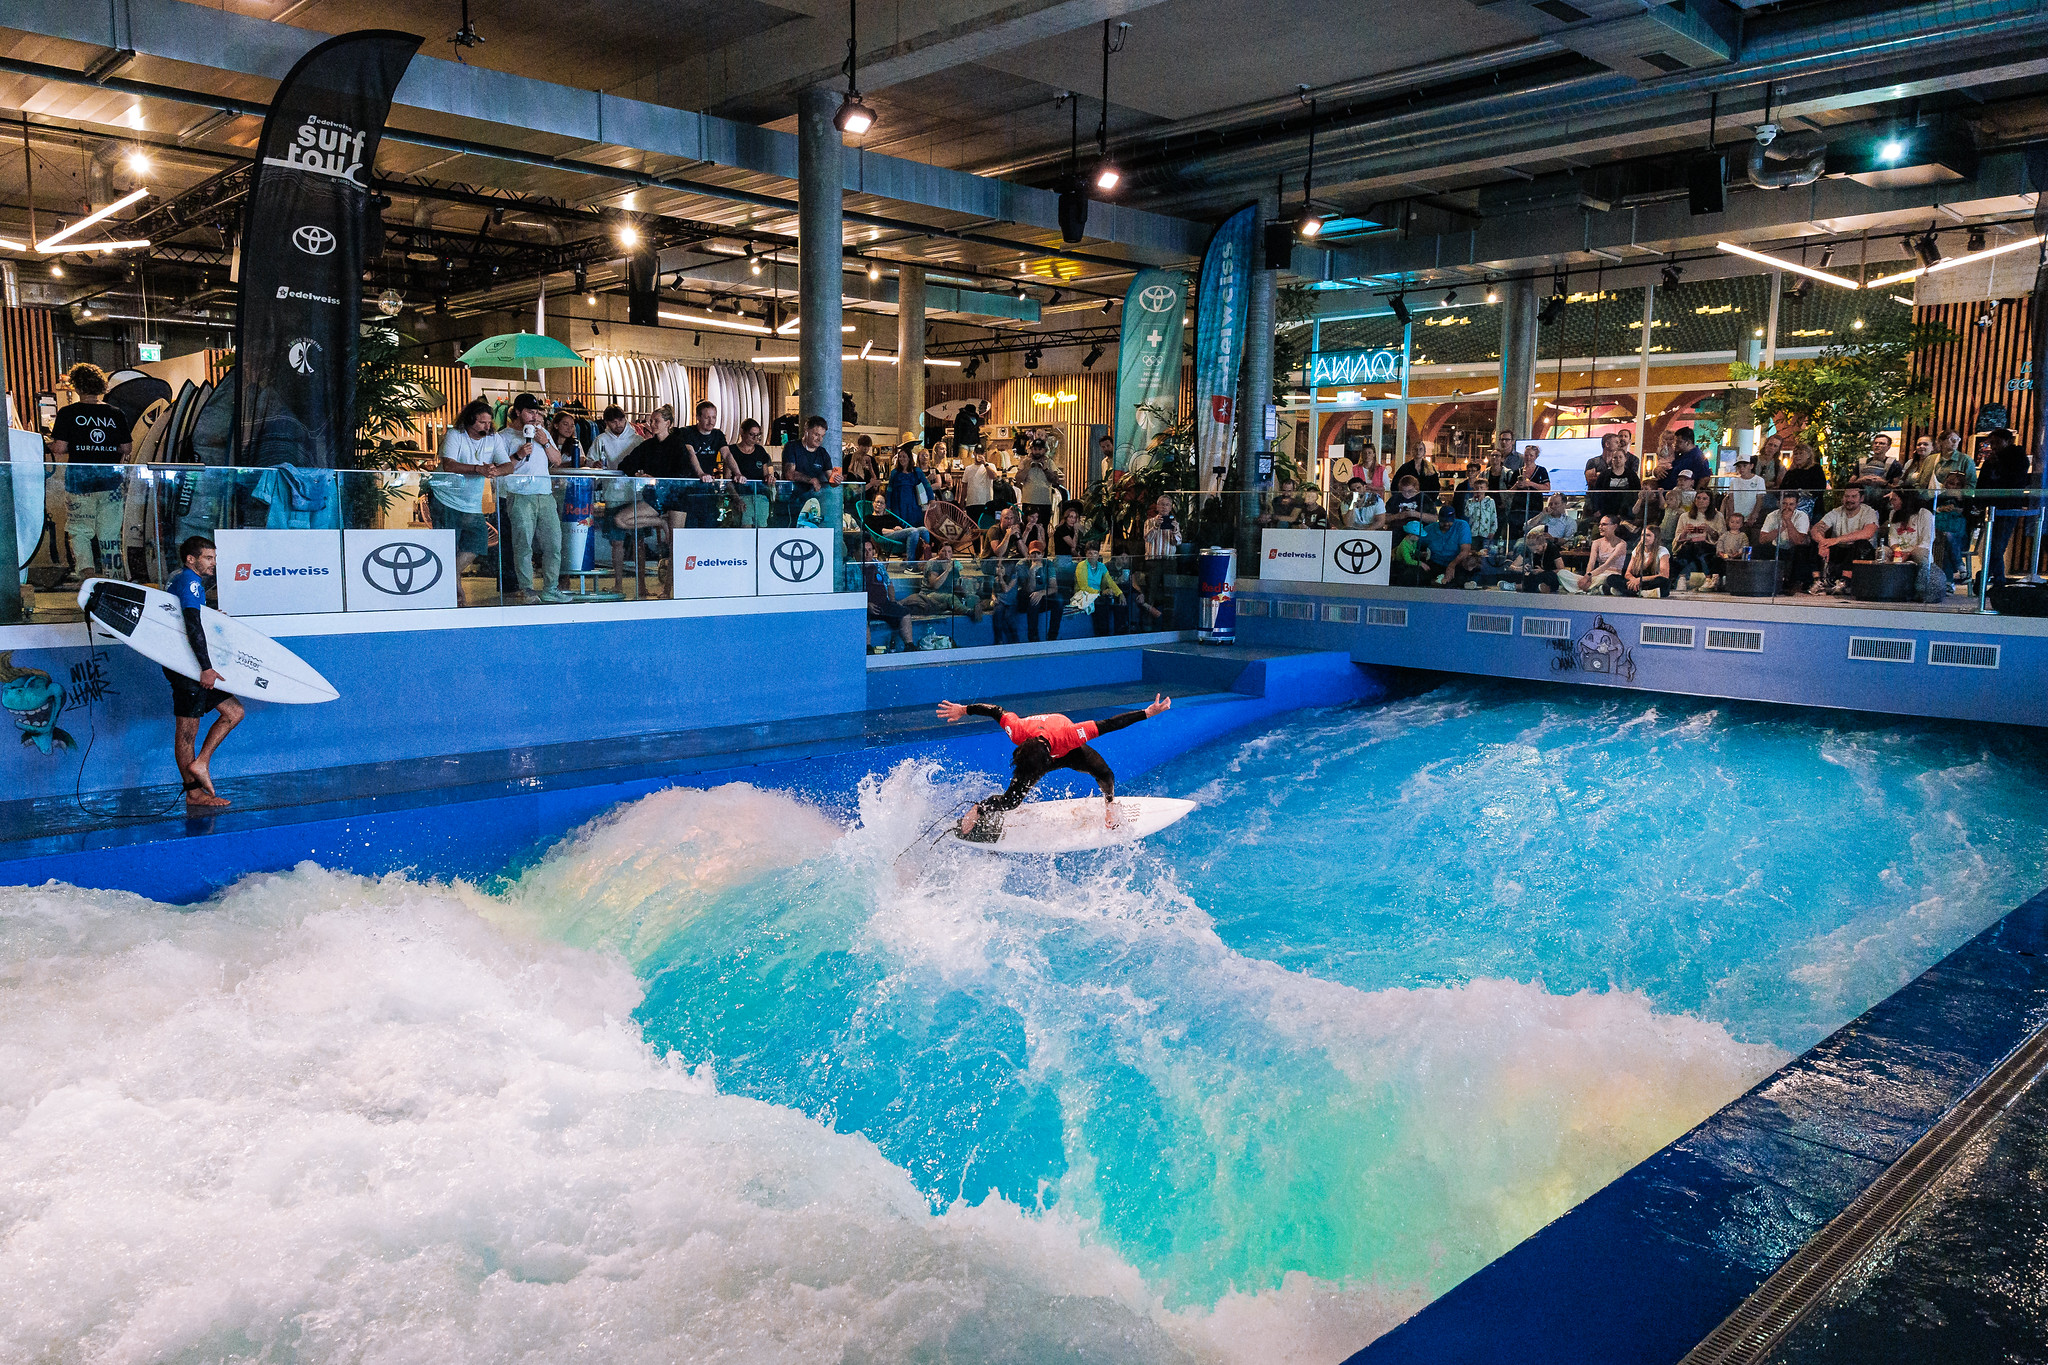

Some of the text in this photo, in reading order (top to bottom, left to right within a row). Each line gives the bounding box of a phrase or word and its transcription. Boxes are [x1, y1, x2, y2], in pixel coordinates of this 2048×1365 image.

[316, 118, 353, 133] edelweiss
[297, 124, 367, 164] surf
[289, 290, 341, 305] edelweiss
[75, 415, 117, 429] OANA
[565, 503, 589, 515] Red
[1277, 551, 1317, 559] edelweiss
[696, 557, 748, 567] edelweiss
[252, 565, 330, 577] edelweiss
[1201, 582, 1222, 593] Red
[70, 651, 109, 683] NICE
